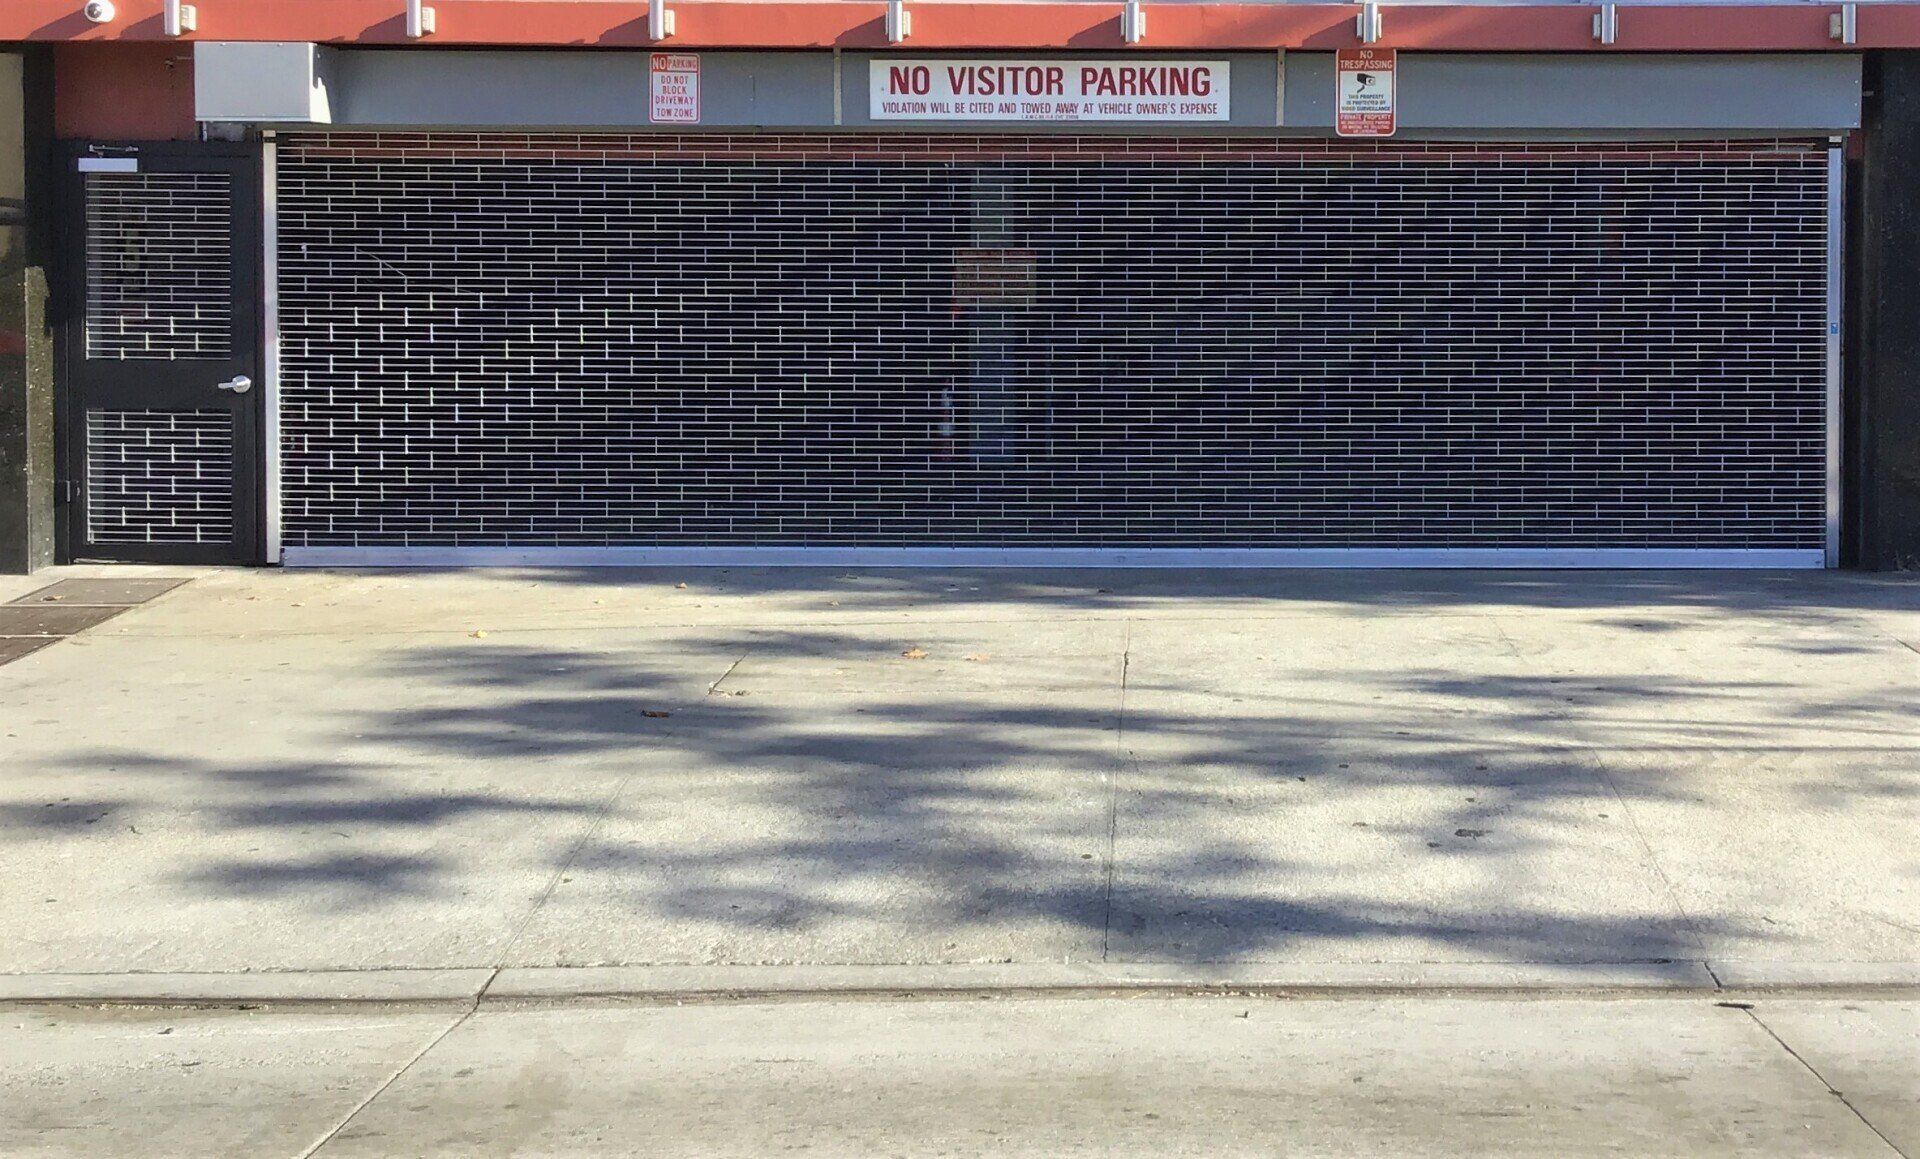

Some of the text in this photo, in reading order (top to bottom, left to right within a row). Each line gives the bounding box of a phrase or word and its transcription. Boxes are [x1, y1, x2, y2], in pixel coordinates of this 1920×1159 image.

[1360, 51, 1373, 59] NO
[652, 57, 697, 69] NO PARKING
[1340, 60, 1392, 69] TRESPASSING
[661, 76, 688, 84] DO NOT
[889, 66, 1210, 96] NO VISITOR PARKING
[662, 86, 687, 94] BLOCK
[655, 96, 694, 104] DRIVEWAY
[656, 108, 694, 117] TOW ZONE
[882, 102, 1217, 114] VIOLATION WILL BE CITED AND TOWED AWAY AT VEHICLE OWNER'S EXPENSE
